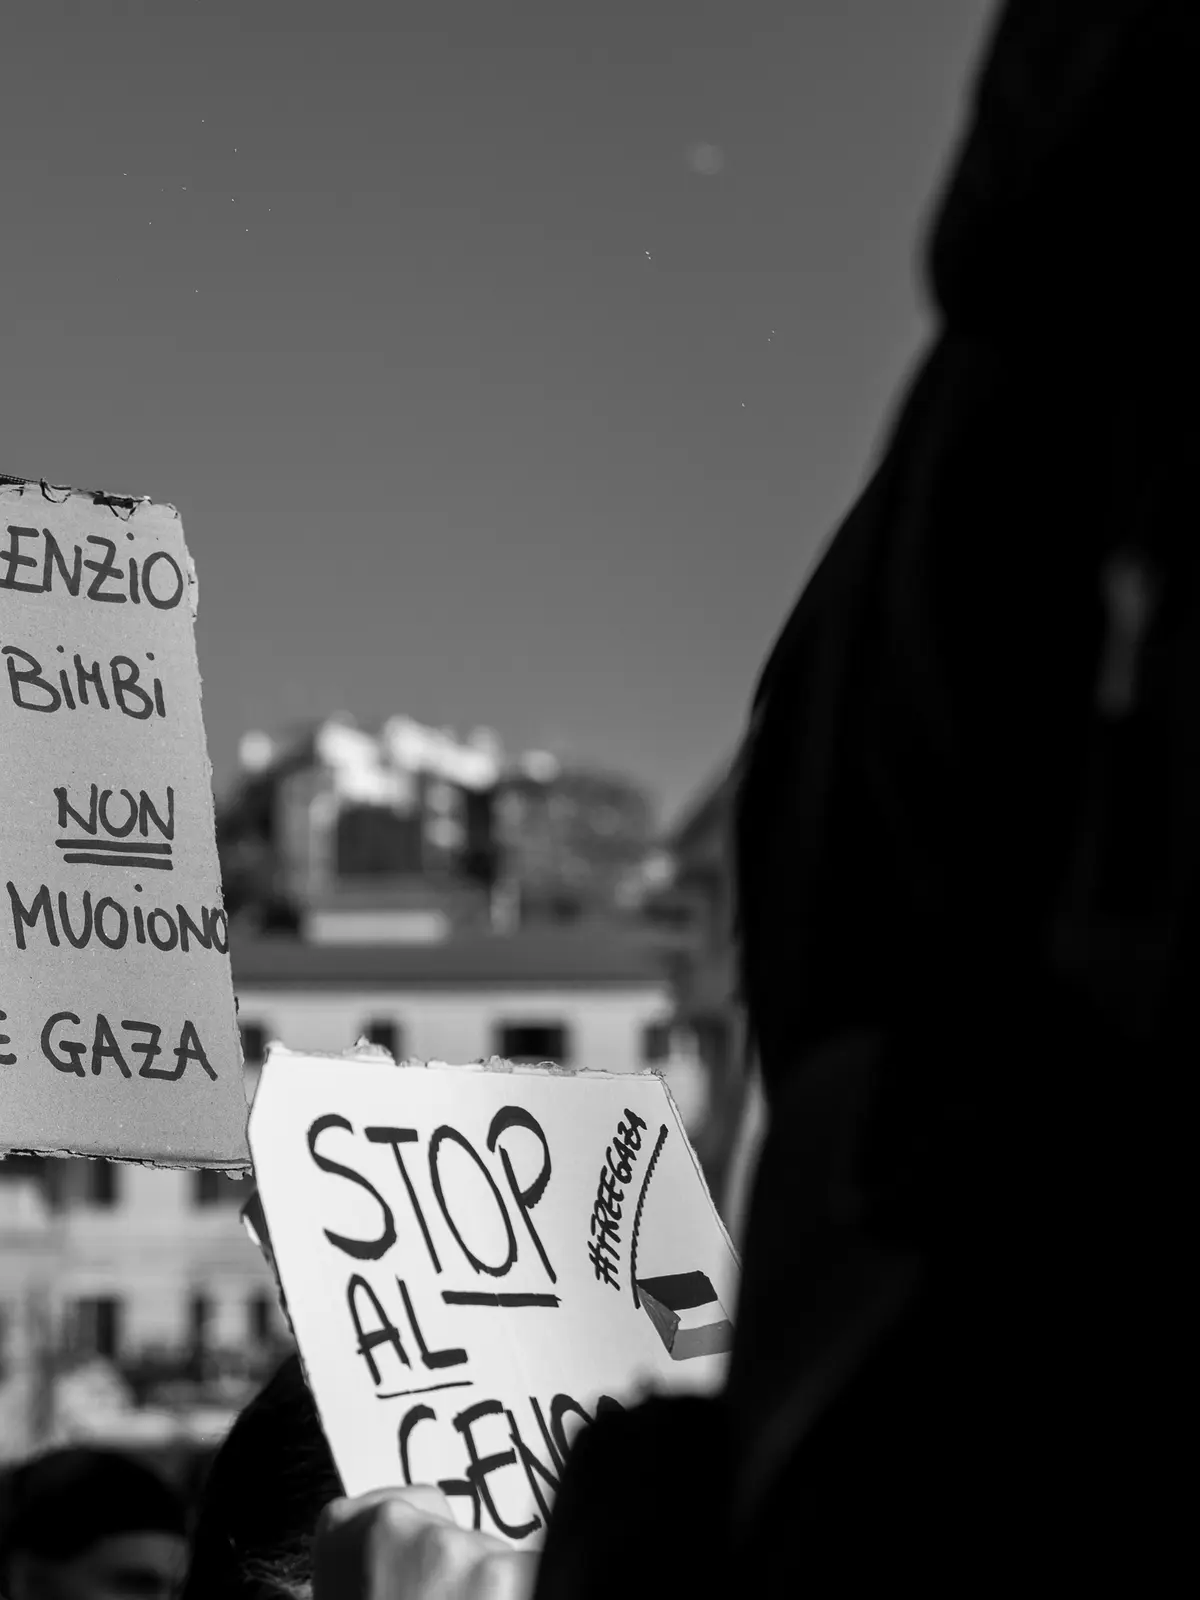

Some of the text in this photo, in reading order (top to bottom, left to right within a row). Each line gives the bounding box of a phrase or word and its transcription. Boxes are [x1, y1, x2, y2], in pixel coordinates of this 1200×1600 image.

[53, 784, 175, 842] NON
[40, 1011, 219, 1082] GAZA
[307, 1105, 557, 1285] STOP
[347, 1273, 468, 1386] AL
